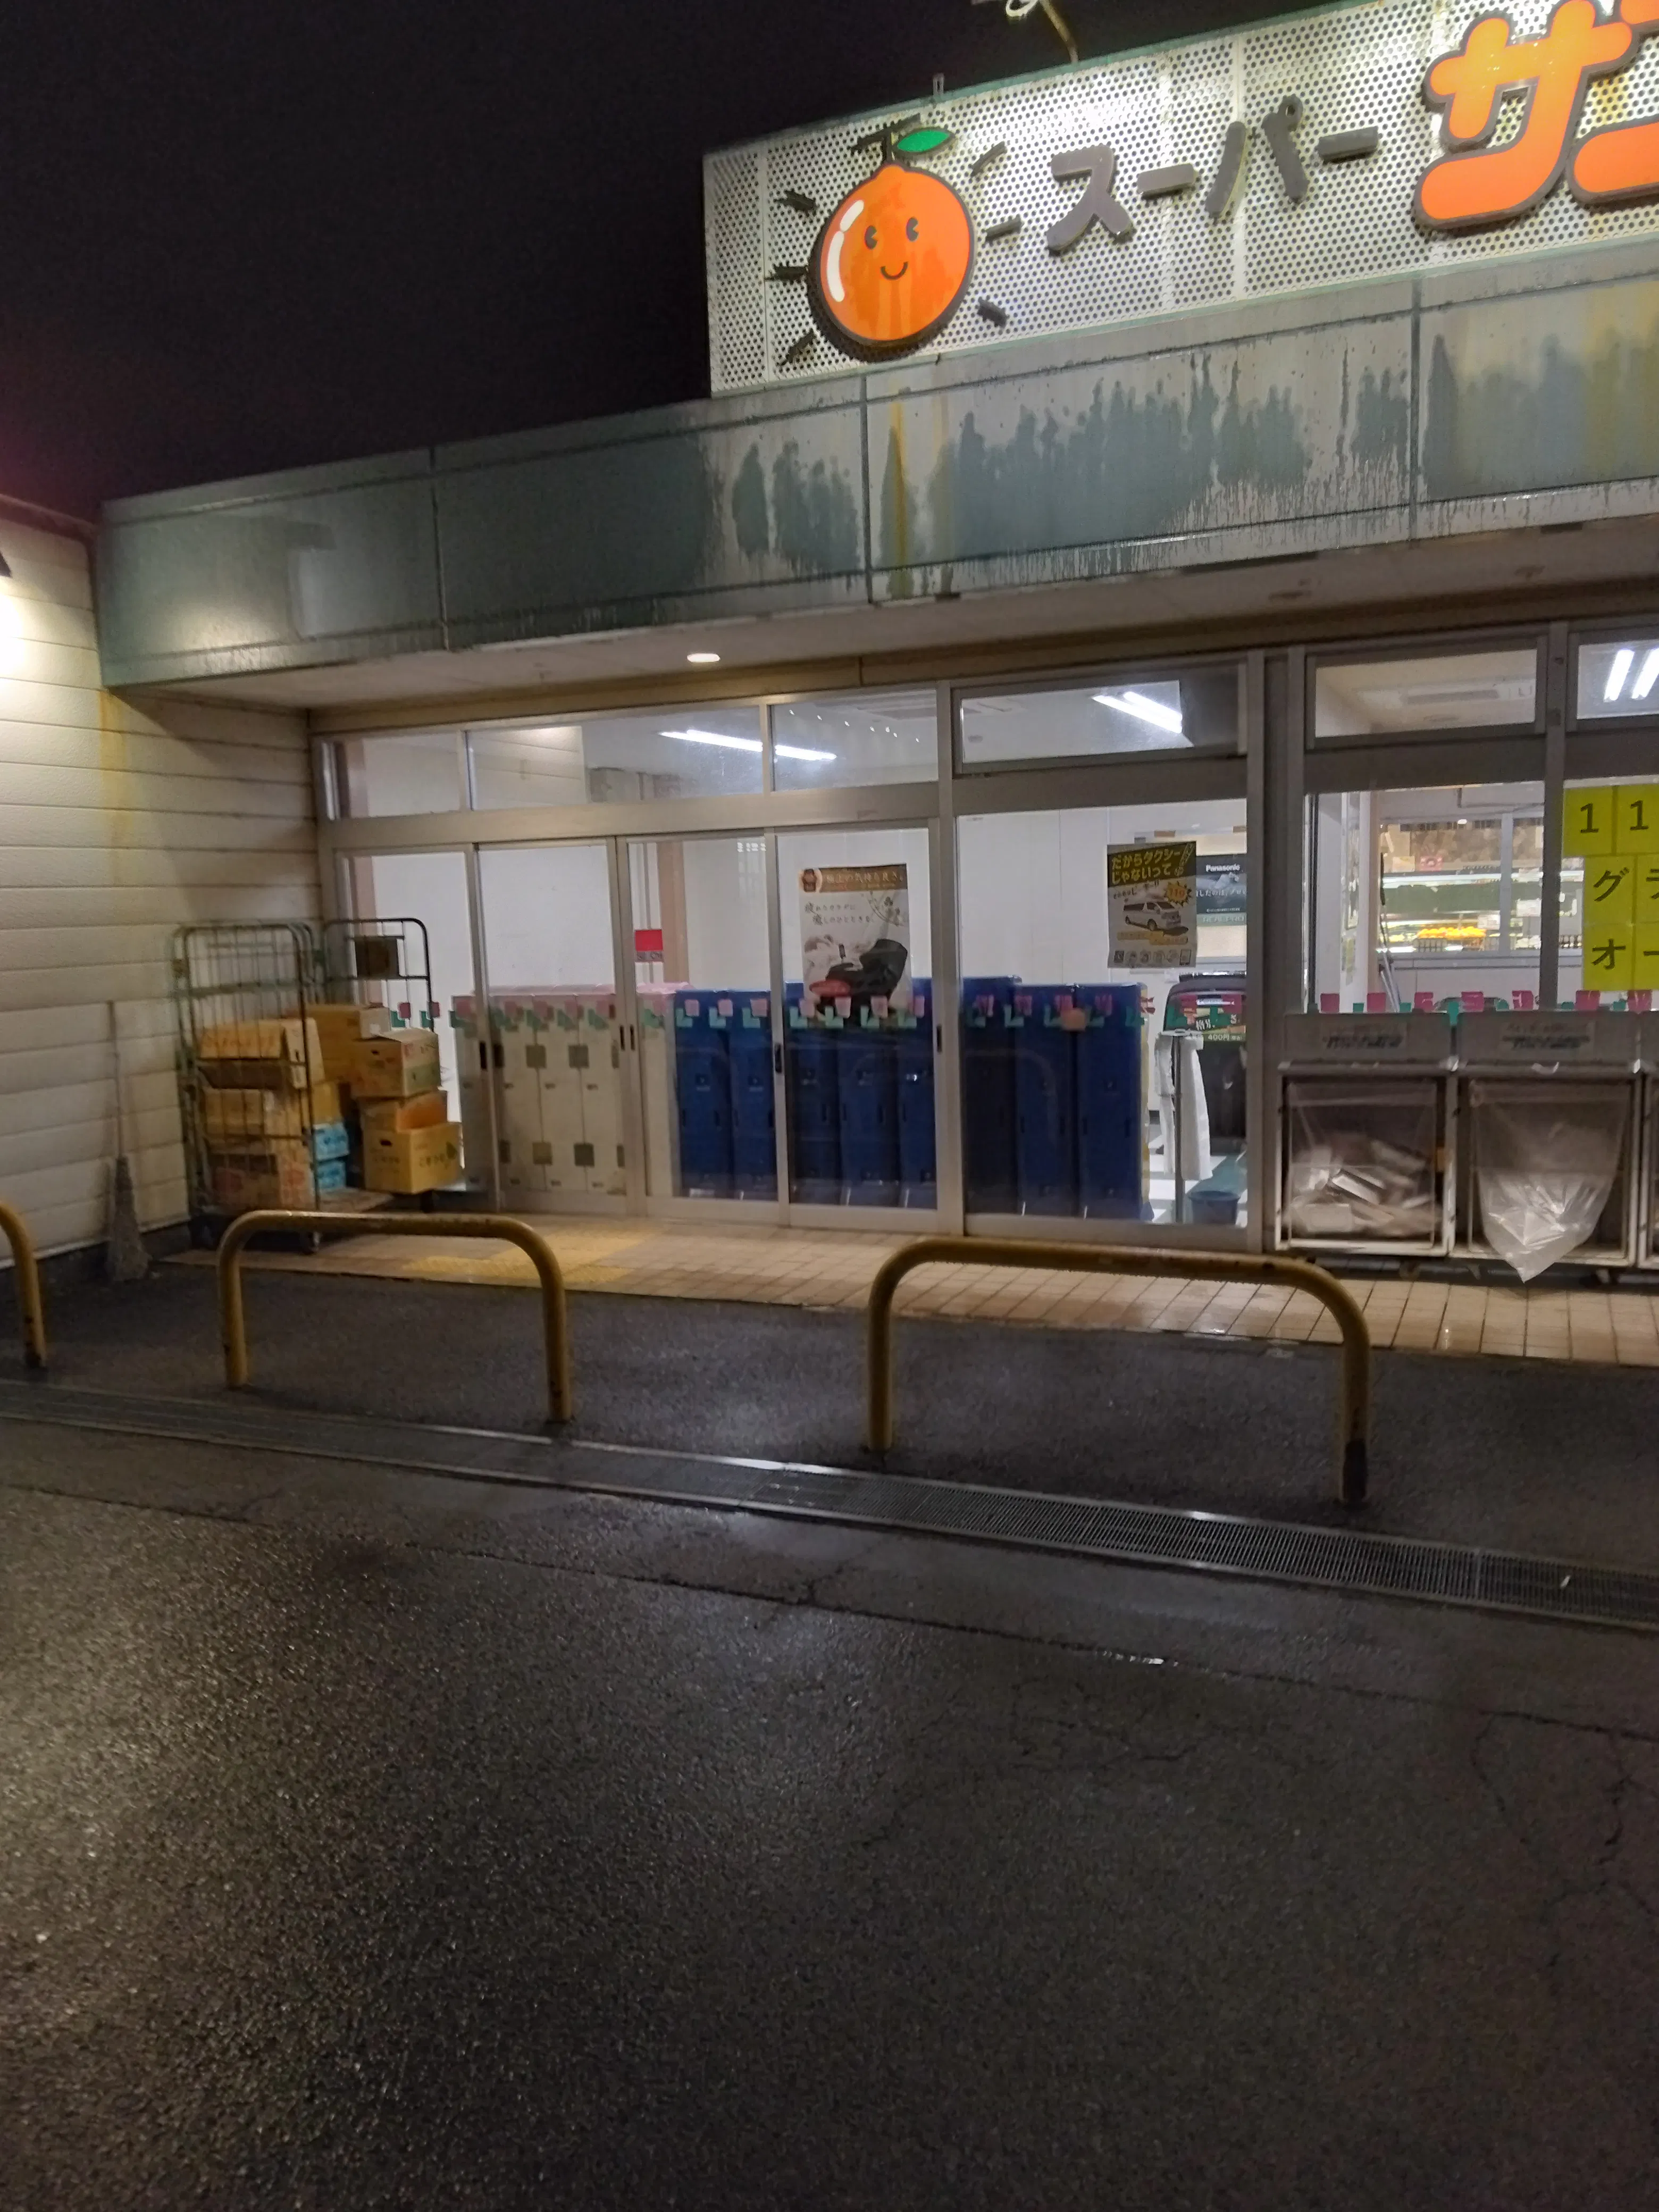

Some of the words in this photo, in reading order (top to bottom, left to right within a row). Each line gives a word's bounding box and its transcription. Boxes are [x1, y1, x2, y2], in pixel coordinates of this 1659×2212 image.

[1045, 94, 1379, 252] スーパー
[1414, 0, 1659, 228] サ
[1112, 848, 1180, 870] だからタクシー
[1205, 864, 1241, 872] Panasonic
